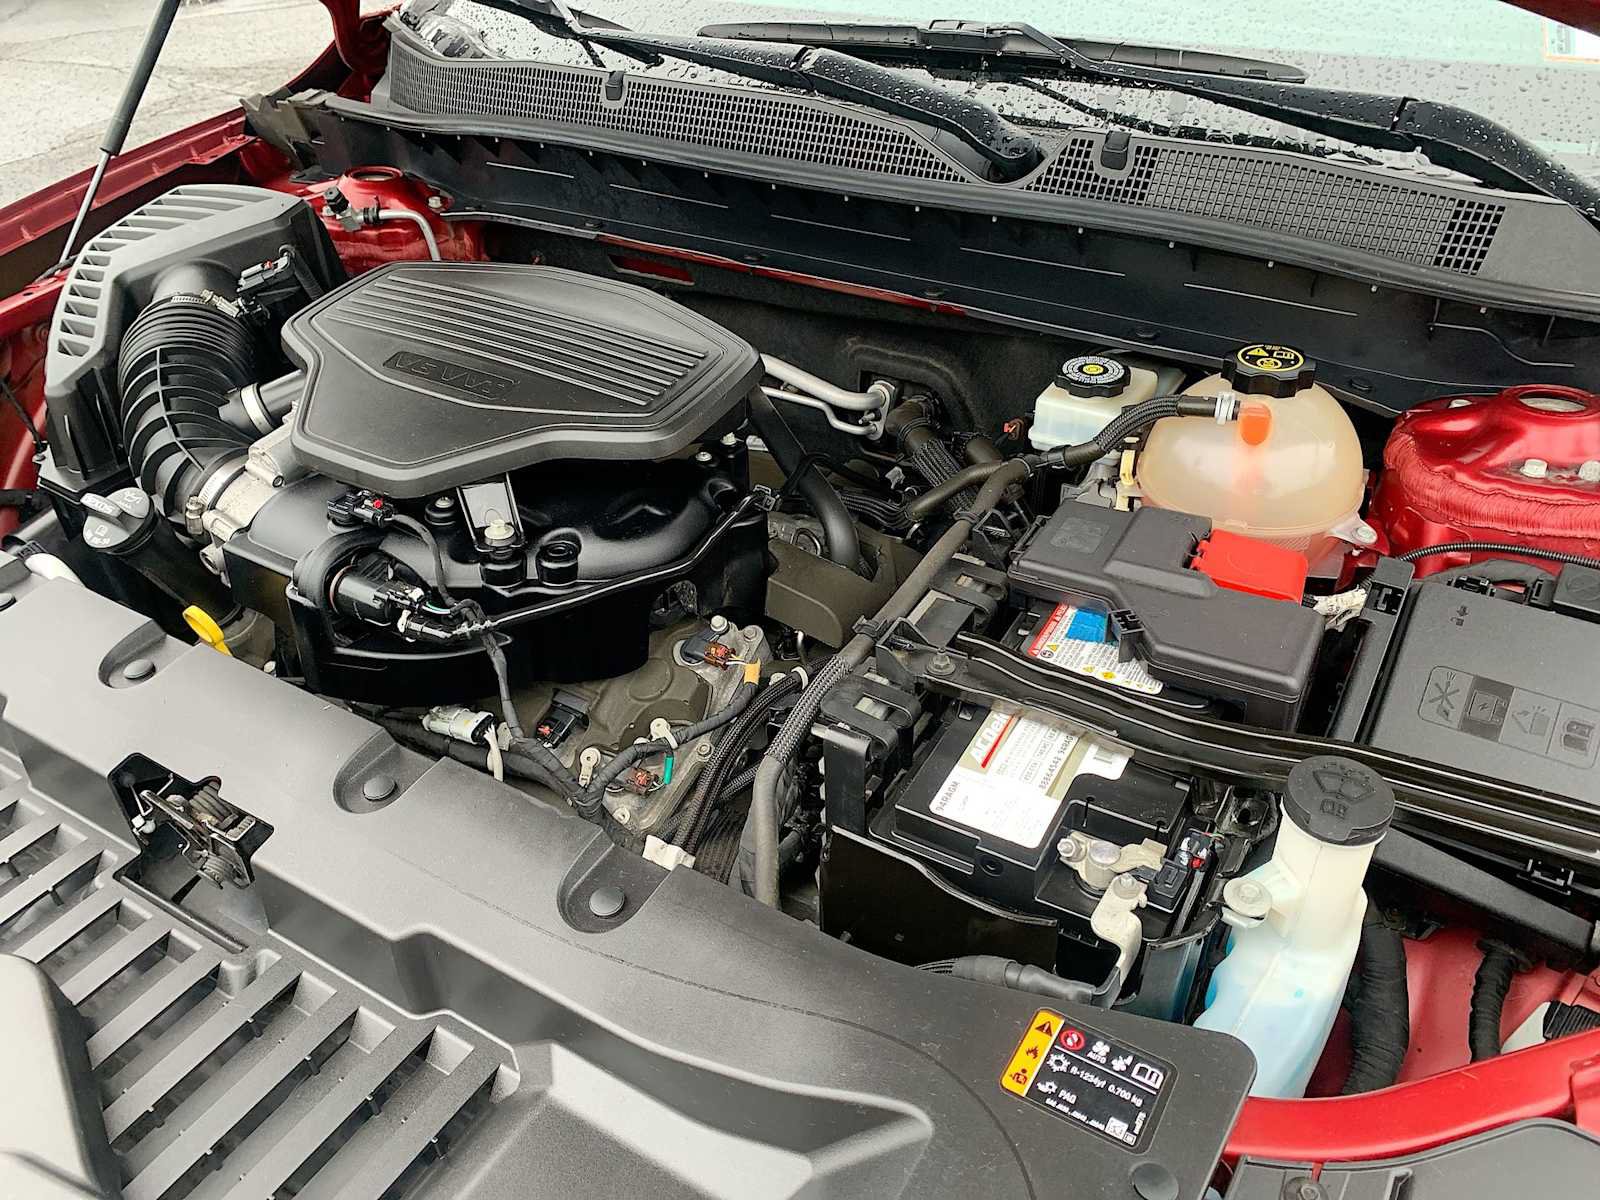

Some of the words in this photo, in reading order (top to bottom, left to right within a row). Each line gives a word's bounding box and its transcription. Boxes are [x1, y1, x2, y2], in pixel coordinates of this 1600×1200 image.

[1086, 1051, 1107, 1065] AUTO
[1069, 1065, 1107, 1089] R-1234yf
[1107, 1084, 1132, 1101] 0.700
[1130, 1093, 1143, 1108] kg
